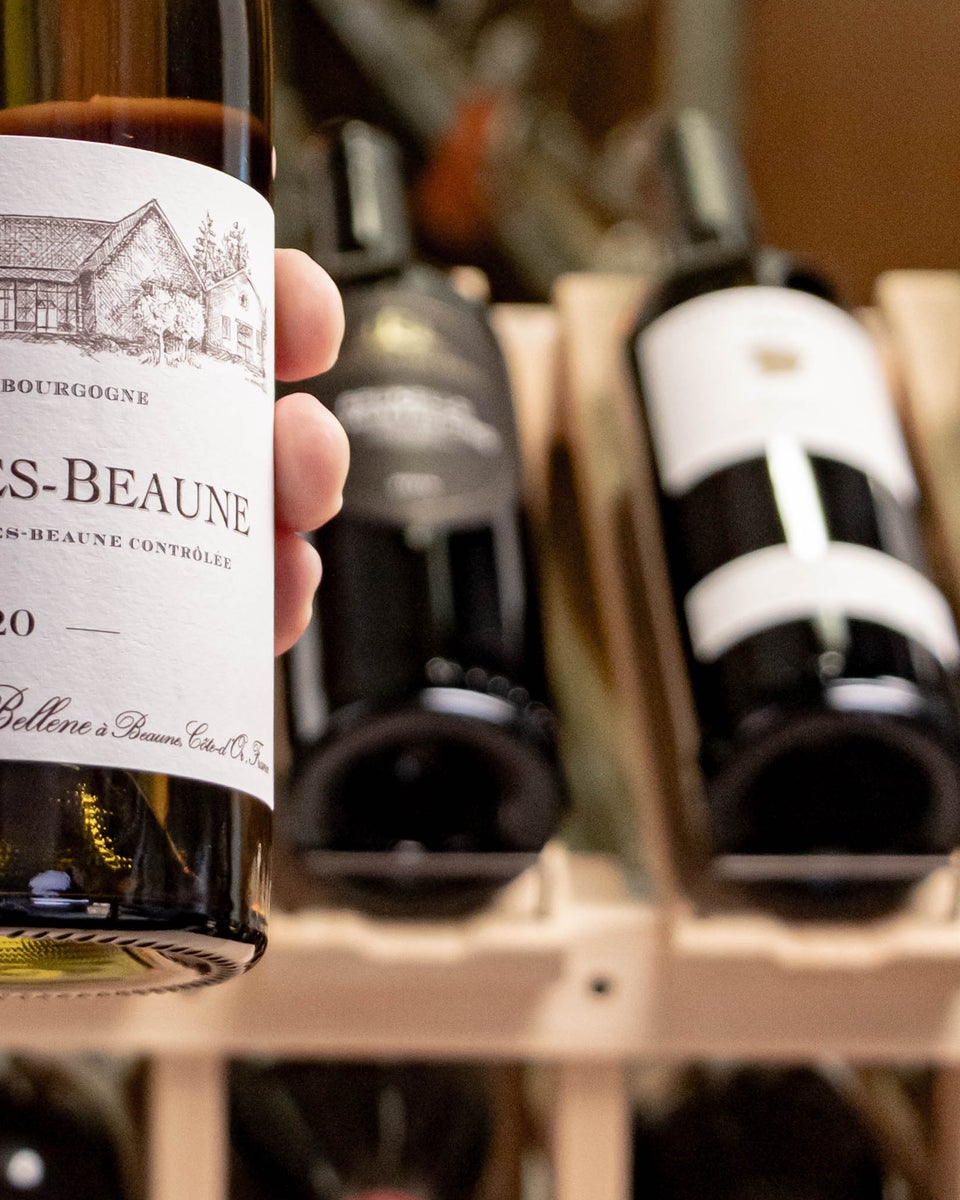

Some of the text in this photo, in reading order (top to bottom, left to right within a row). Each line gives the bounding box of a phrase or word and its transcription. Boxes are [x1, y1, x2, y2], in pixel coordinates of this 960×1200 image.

[0, 378, 149, 405] BOURGOGNE
[129, 537, 232, 570] CONTRÔLÉE
[95, 722, 108, 736] à
[111, 710, 184, 748] Beaune,
